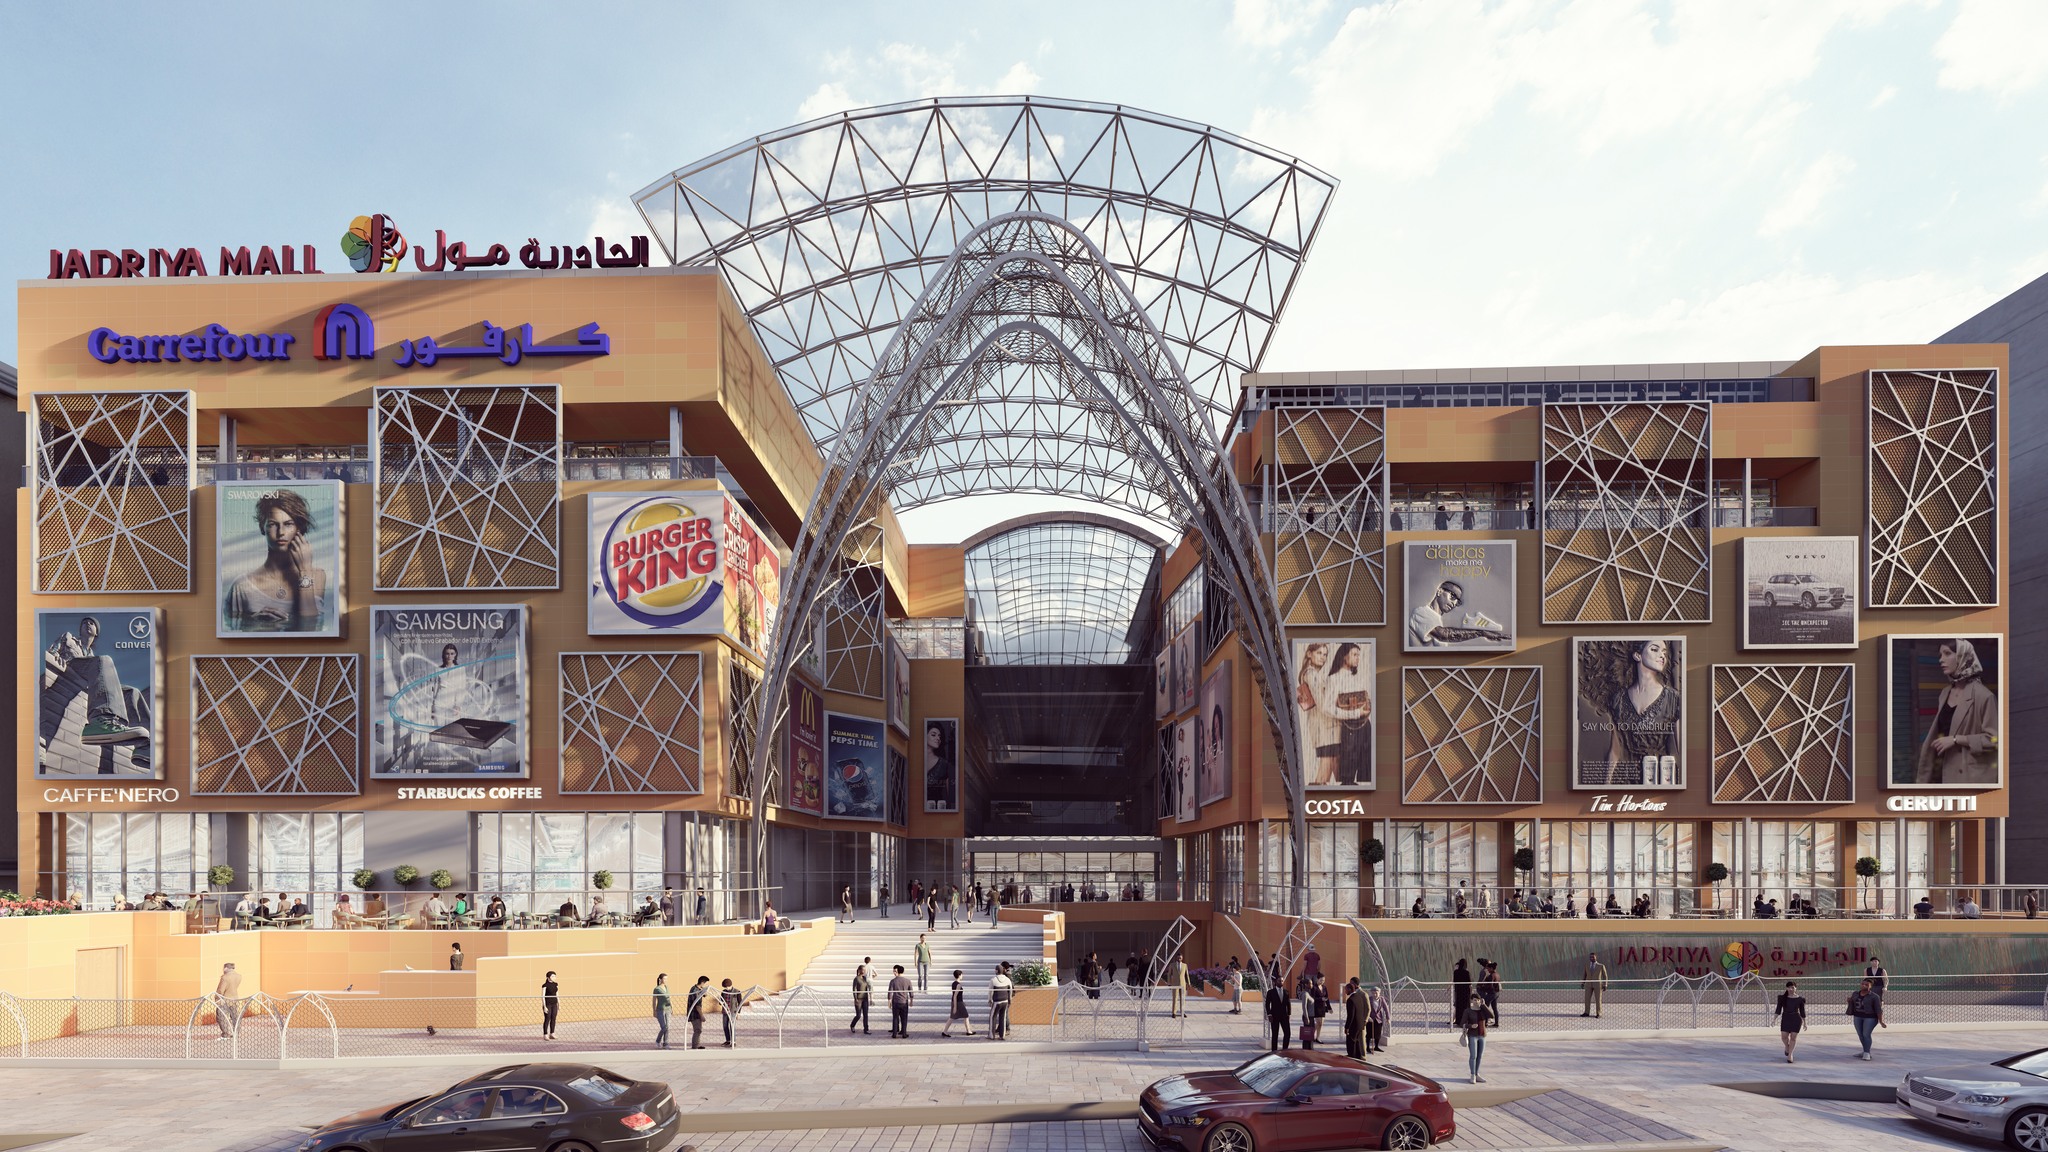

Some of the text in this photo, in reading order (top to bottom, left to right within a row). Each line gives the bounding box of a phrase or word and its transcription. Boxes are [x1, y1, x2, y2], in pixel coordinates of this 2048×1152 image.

[414, 229, 510, 272] مول
[47, 244, 325, 279] JADRIYA MALL
[88, 323, 296, 364] Carrefour
[392, 320, 610, 368] كارفور
[227, 490, 280, 499] SWAROVSKI
[612, 517, 713, 569] BURGER
[723, 523, 750, 561] CRISPY
[1425, 545, 1485, 559] adidas
[617, 540, 717, 602] KING
[1440, 563, 1492, 578] happy
[395, 612, 504, 630] SAMSUNG
[832, 730, 875, 741] SUMMER TIME
[1582, 722, 1598, 731] SAY
[1599, 722, 1615, 731] NO
[1617, 722, 1630, 731] TO
[830, 736, 856, 745] PEPSI
[858, 739, 879, 748] TIME
[43, 787, 180, 803] CAFFE'NERO
[397, 787, 543, 799] STARBUCKS COFFEE
[1304, 799, 1365, 815] COSTA
[1590, 794, 1668, 812] Tim Hortons
[1886, 795, 1977, 811] CERUTTI
[1617, 946, 1713, 965] JADRIYA
[1770, 946, 1867, 966] الجادرية
